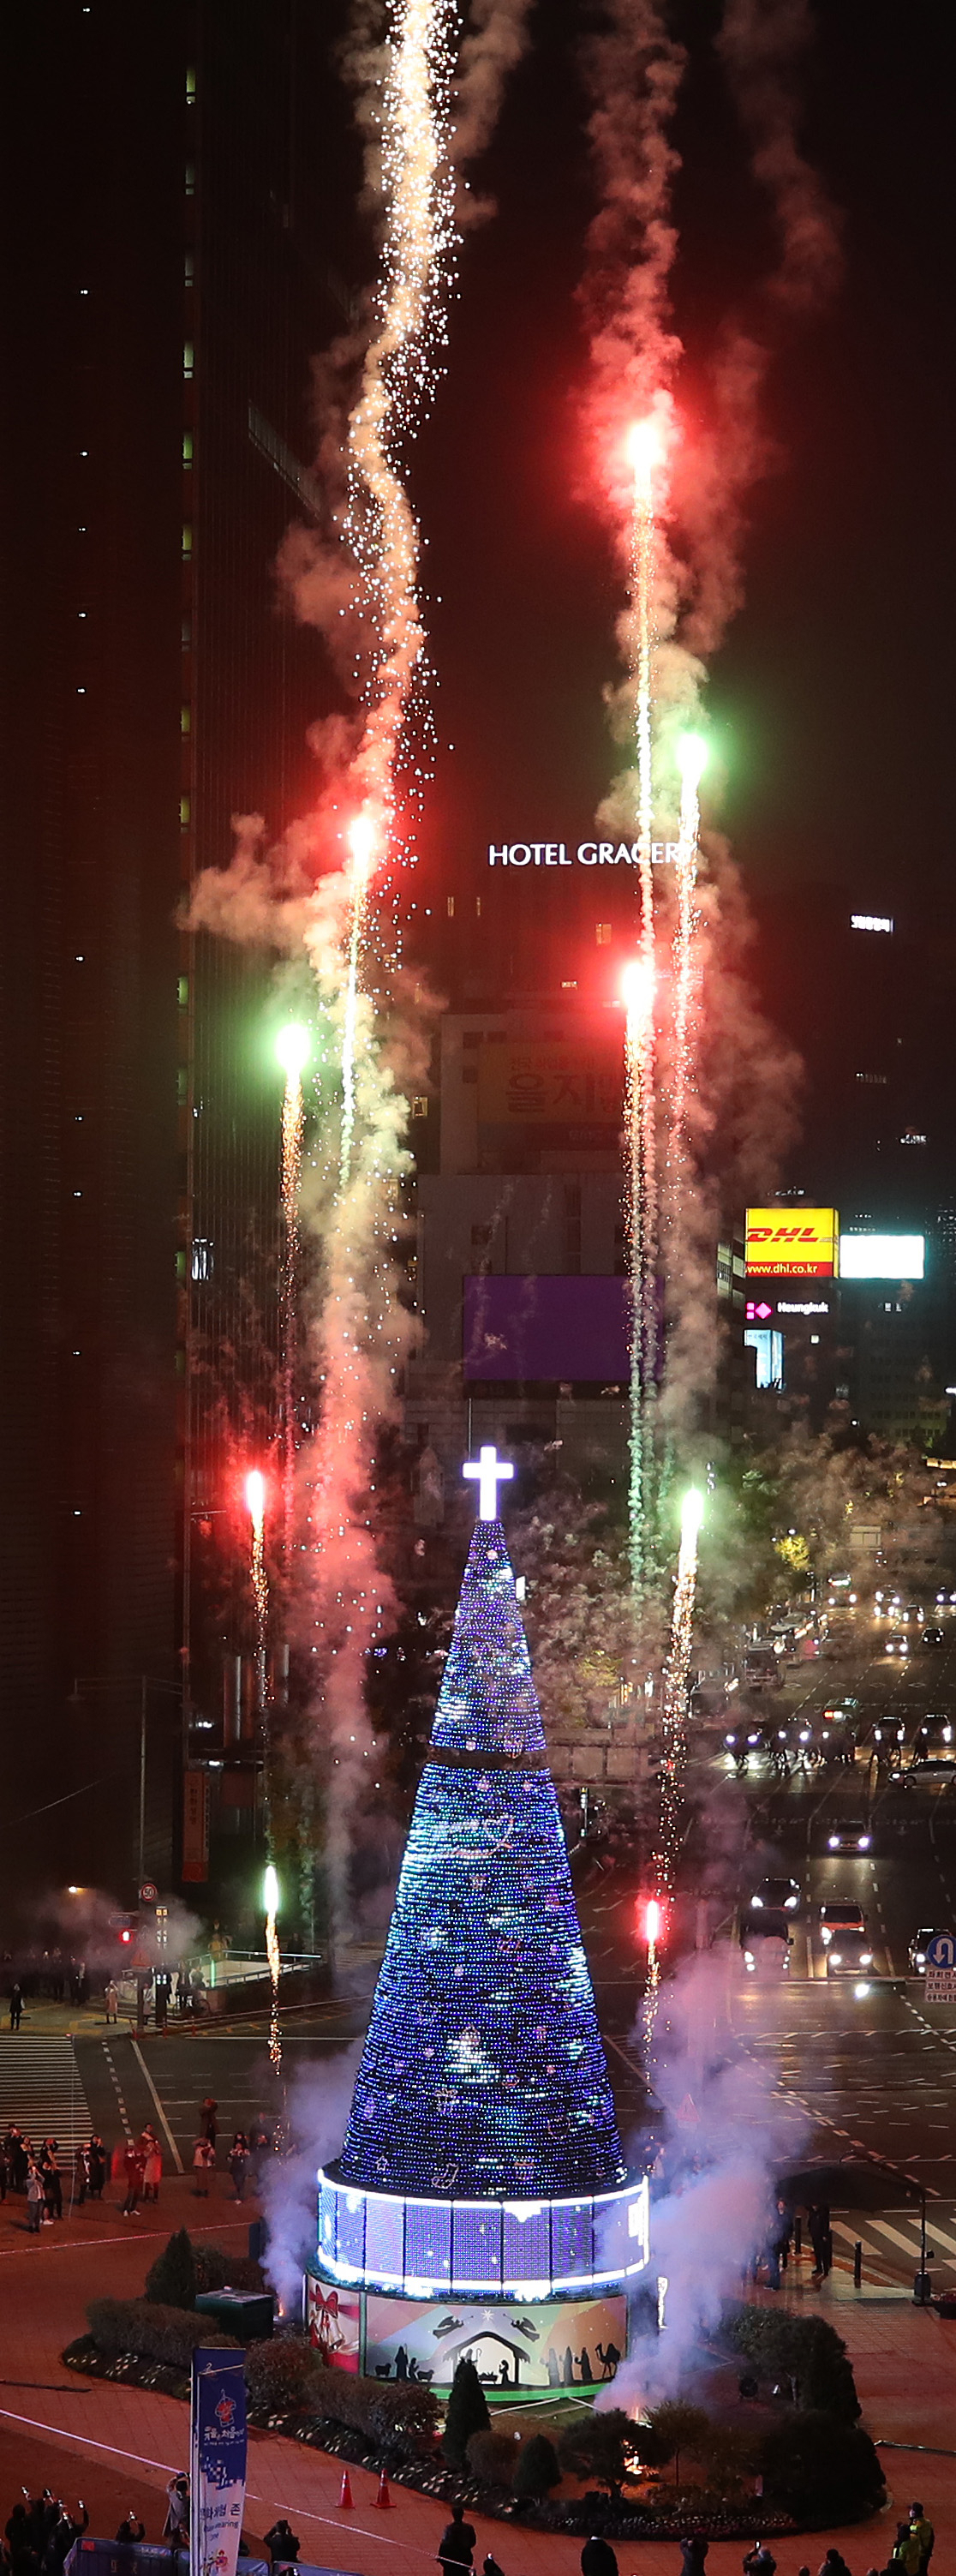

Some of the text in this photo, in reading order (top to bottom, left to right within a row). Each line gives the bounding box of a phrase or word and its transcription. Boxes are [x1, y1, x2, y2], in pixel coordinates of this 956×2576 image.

[489, 843, 572, 866] HOTEL
[747, 1227, 820, 1242] DHL
[777, 1302, 828, 1315] Heungkuk
[145, 1888, 153, 1896] 50
[230, 2503, 241, 2516] 존
